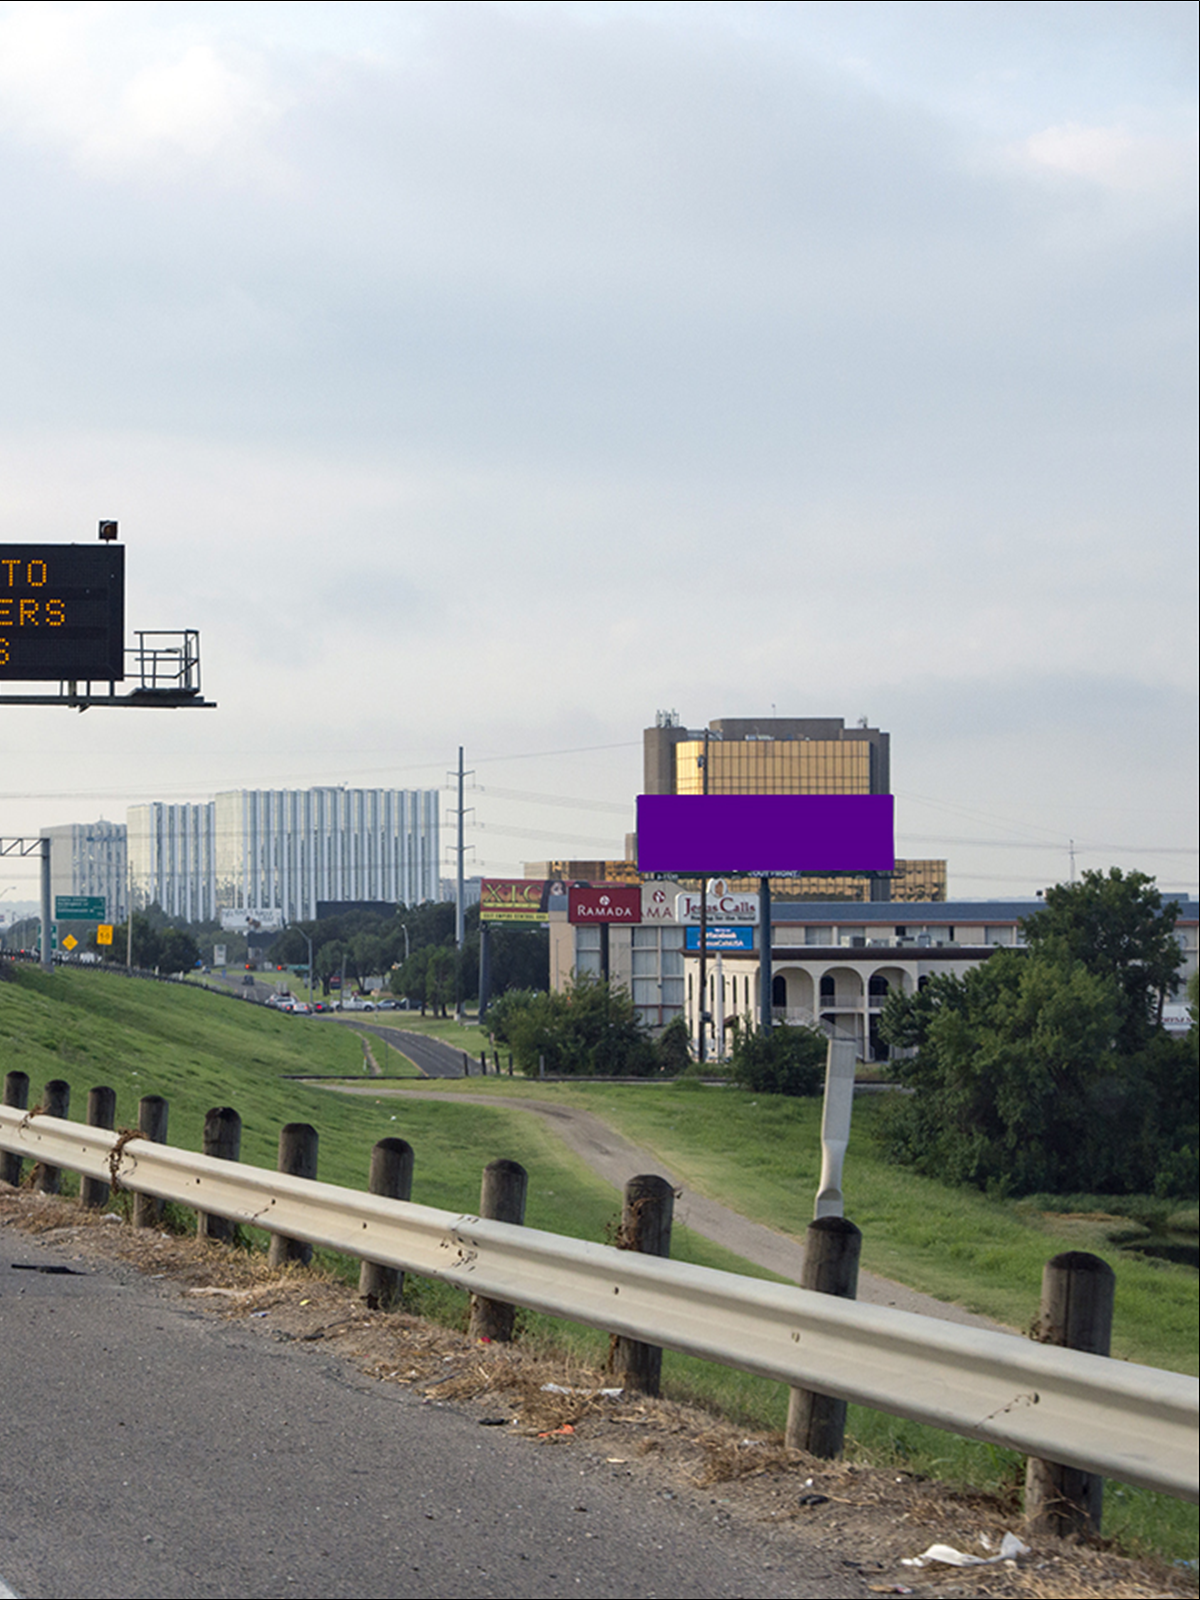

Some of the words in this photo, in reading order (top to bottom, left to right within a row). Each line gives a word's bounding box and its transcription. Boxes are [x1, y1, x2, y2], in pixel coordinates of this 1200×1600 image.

[1, 559, 47, 587] TO
[577, 904, 632, 916] RAMADA
[719, 897, 755, 913] Calls
